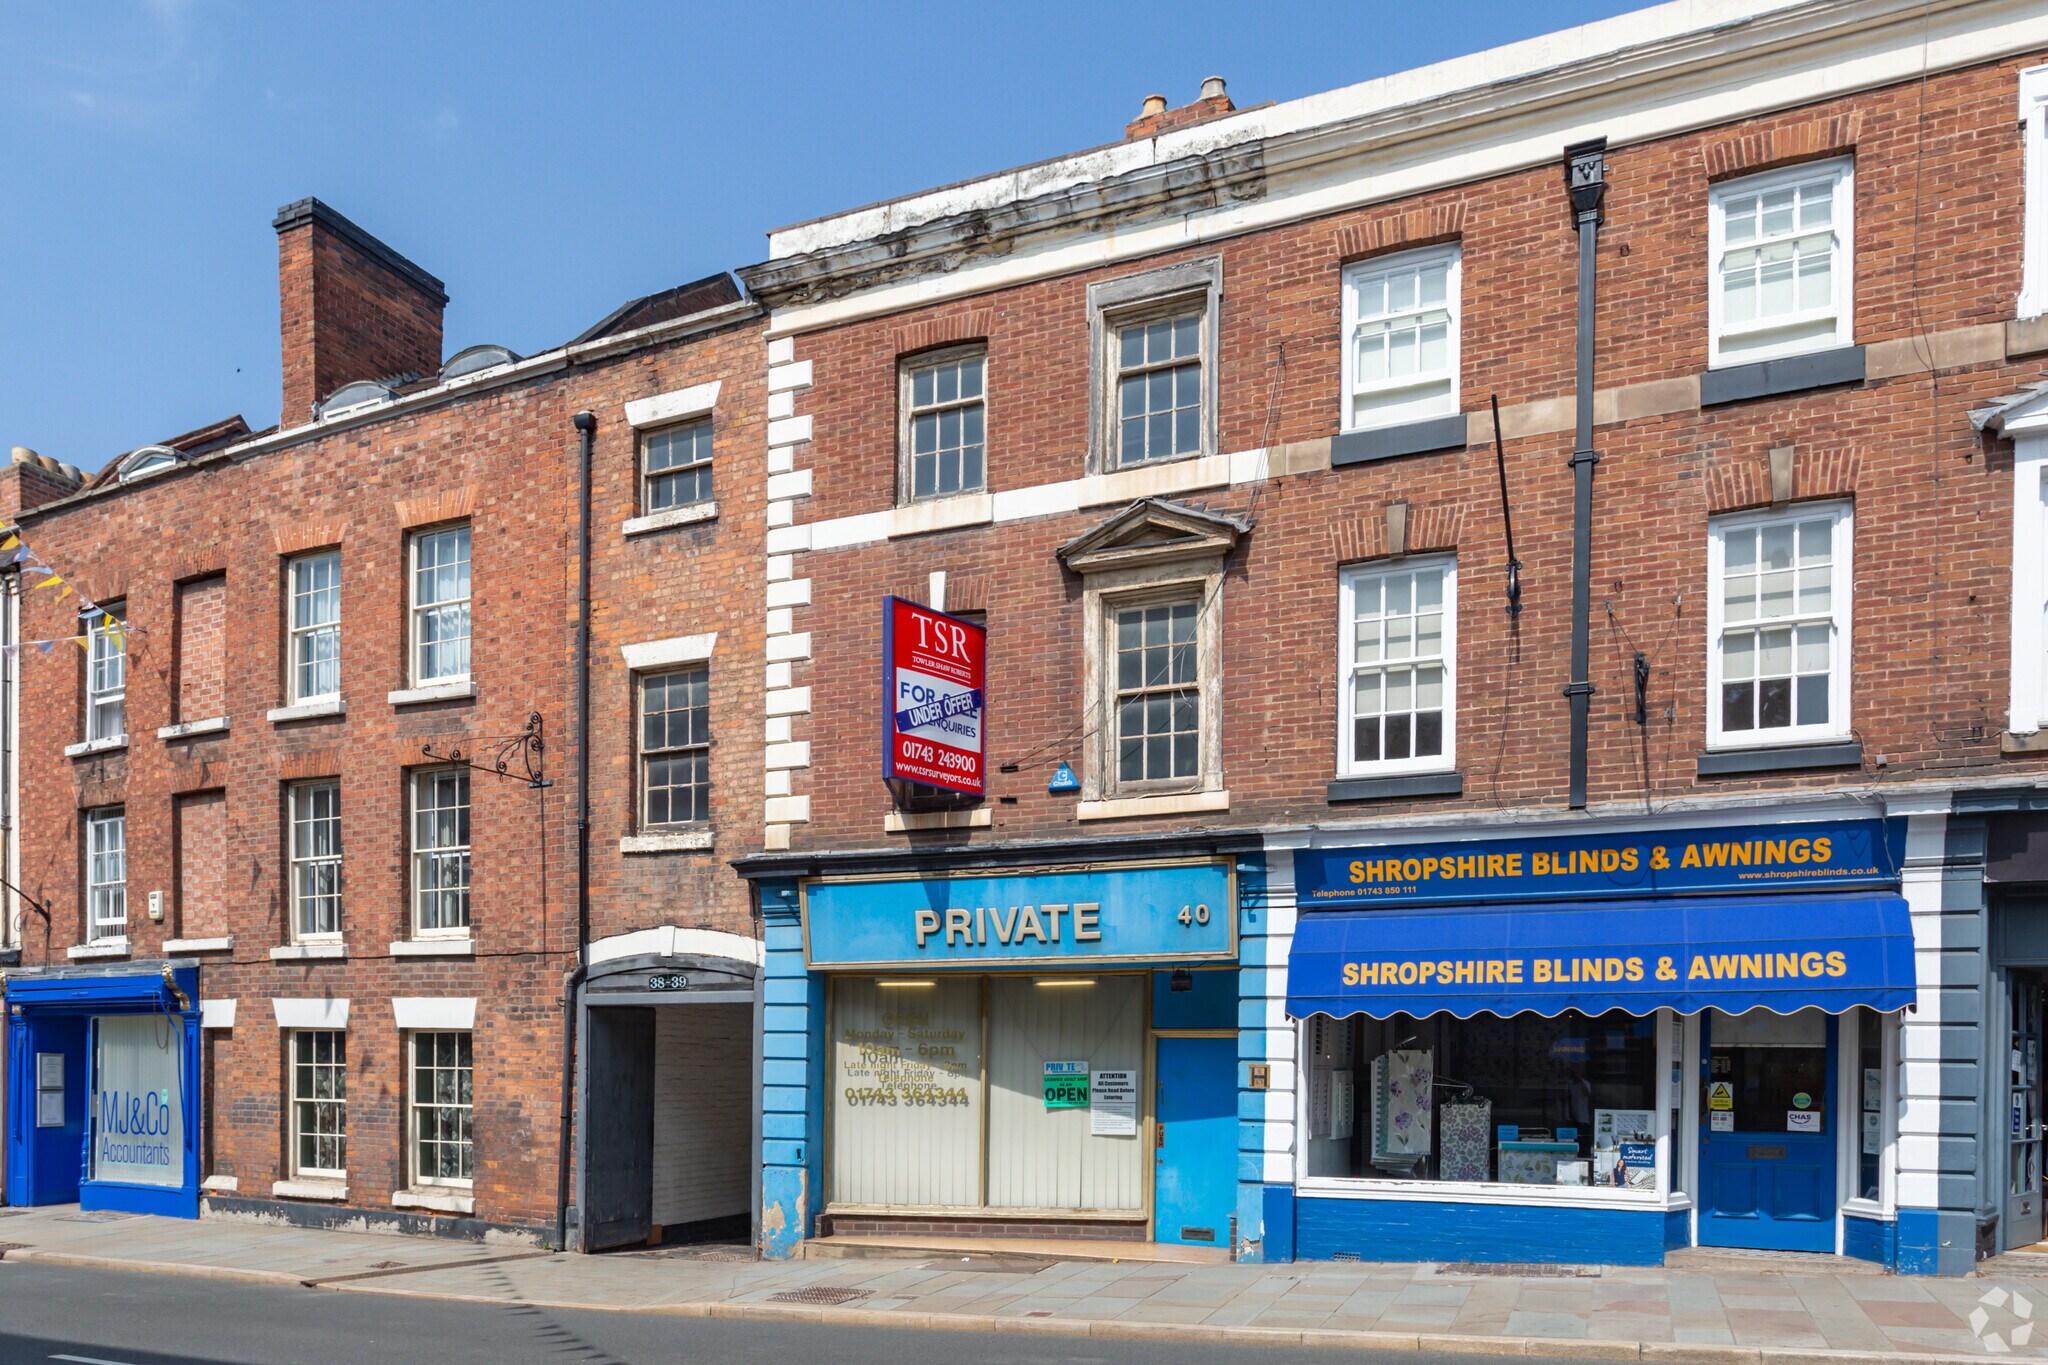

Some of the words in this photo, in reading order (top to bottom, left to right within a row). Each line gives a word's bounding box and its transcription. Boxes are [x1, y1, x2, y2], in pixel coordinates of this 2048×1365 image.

[912, 612, 971, 663] TSR
[912, 656, 935, 667] TOWLER
[901, 681, 935, 704] FOR
[908, 702, 943, 727] UNDER
[944, 693, 974, 716] OFFER
[903, 741, 934, 763] 01743
[938, 749, 976, 773] 243900
[895, 762, 981, 787] www.tsrsurveyors.co.uk
[1349, 853, 1523, 883] SHROPSHIRE
[1532, 847, 1639, 875] BLINDS
[1650, 846, 1671, 869] &
[1680, 837, 1832, 868] AWNINGS
[1738, 866, 1879, 879] www.shropshireblinds.co.uk
[1312, 889, 1355, 898] Telephone
[1357, 887, 1382, 895] 01743
[1385, 886, 1400, 894] 850
[1403, 885, 1416, 893] 111
[915, 902, 1101, 947] PRIVATE
[1177, 904, 1210, 927] 40
[1342, 959, 1523, 986] SHROPSHIRE
[1533, 956, 1644, 983] BLINDS
[1655, 956, 1678, 981] &
[1688, 951, 1847, 980] AWNINGS
[650, 976, 686, 989] 38-39
[882, 1010, 929, 1026] OPEN
[845, 1028, 894, 1040] Monday
[907, 1027, 966, 1040] Saturday
[859, 1042, 900, 1056] 10am
[918, 1043, 955, 1058] 6pm
[844, 1060, 867, 1069] Late
[870, 1060, 897, 1070] night
[901, 1060, 932, 1071] Friday
[845, 1087, 894, 1099] 01743
[901, 1087, 966, 1099] 364344
[1045, 1087, 1087, 1101] OPEN
[102, 1090, 170, 1135] MJ&Co
[102, 1137, 170, 1166] Accountants
[1628, 1146, 1648, 1154] Smart
